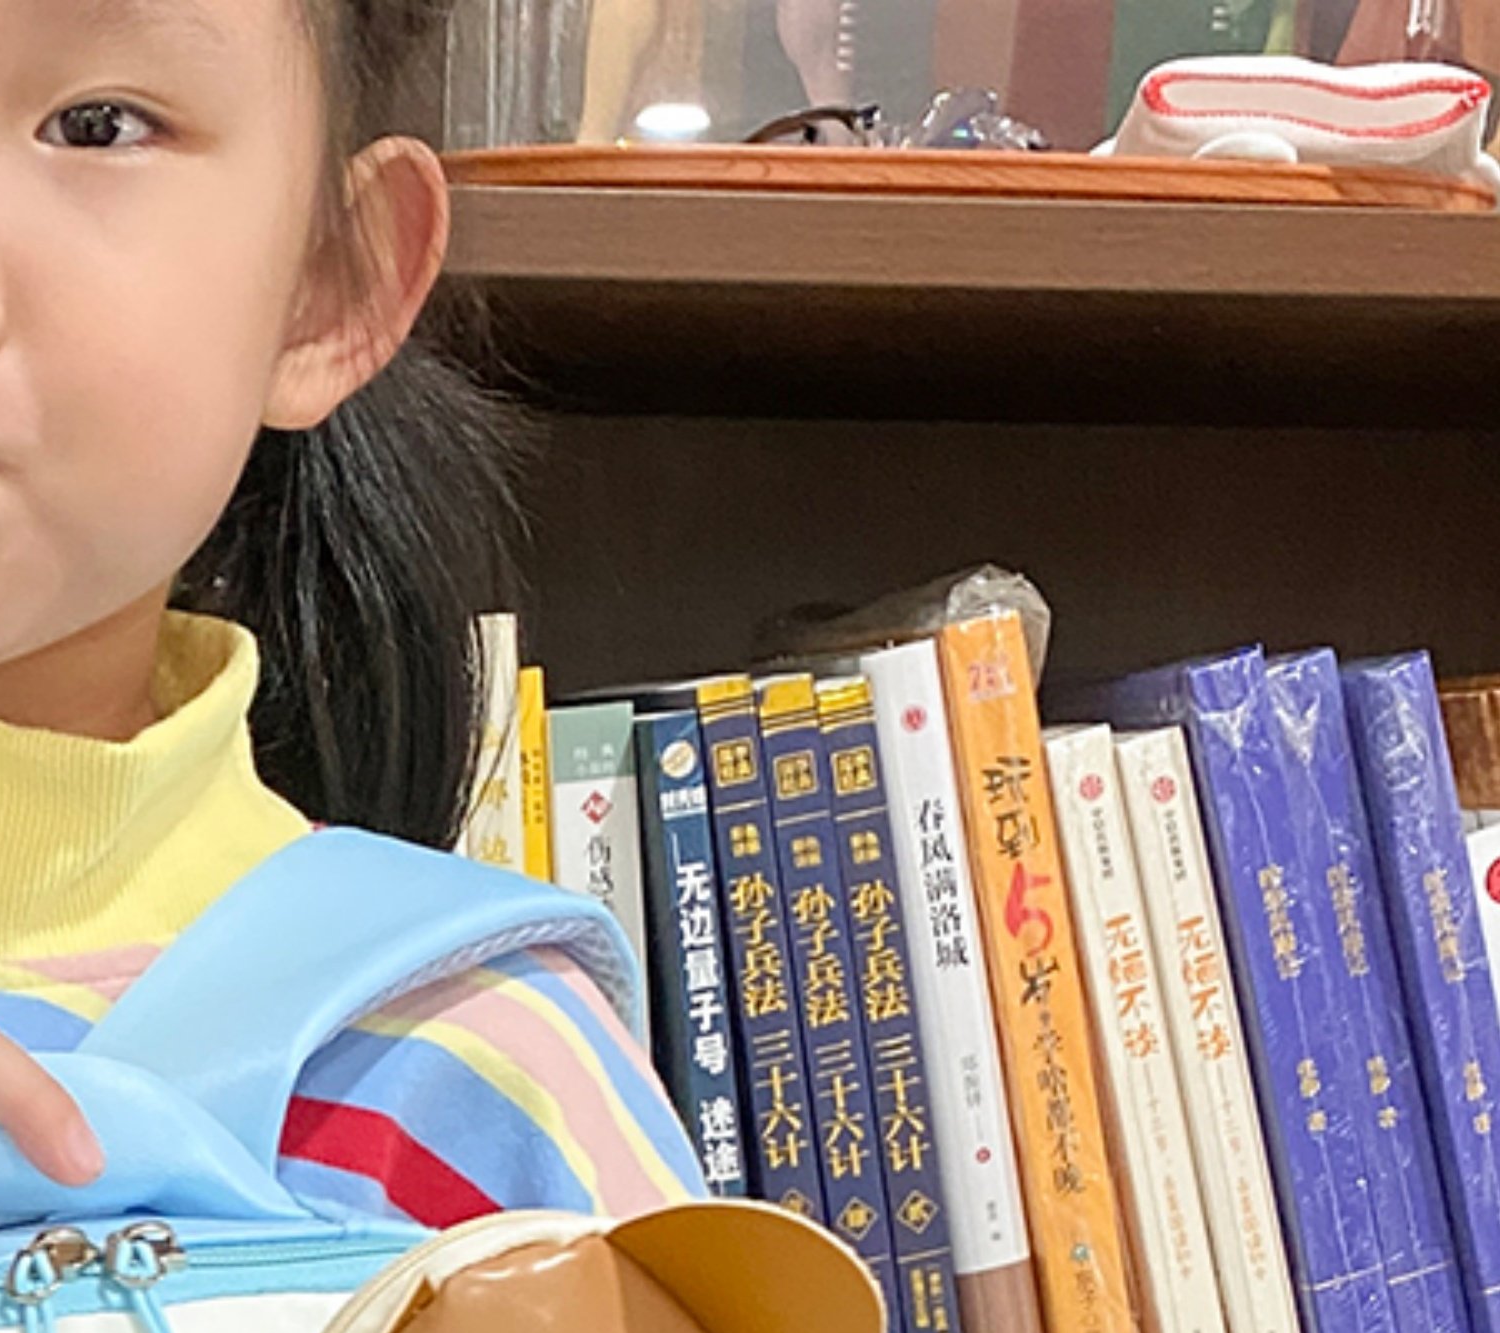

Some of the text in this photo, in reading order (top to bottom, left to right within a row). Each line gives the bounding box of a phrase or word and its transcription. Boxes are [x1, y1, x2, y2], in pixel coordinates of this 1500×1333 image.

[676, 864, 729, 1076] 无边量子号
[916, 799, 970, 969] 春风满洛城
